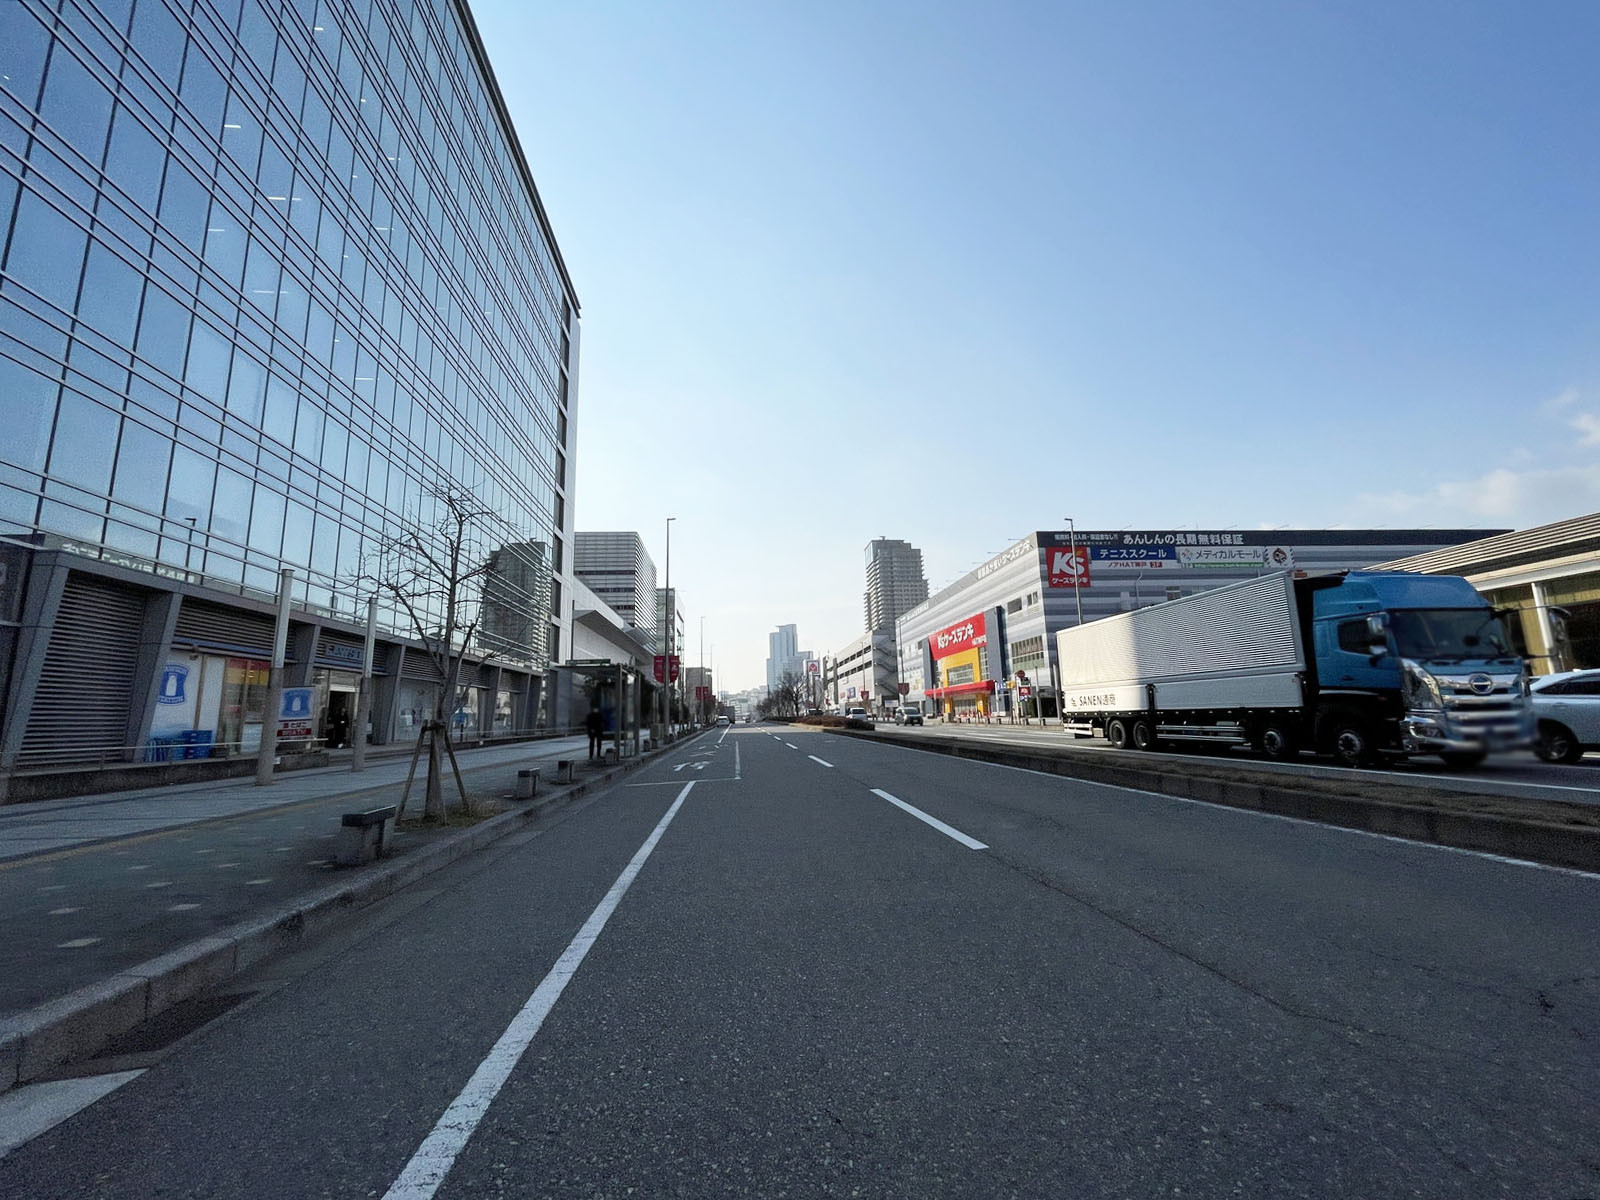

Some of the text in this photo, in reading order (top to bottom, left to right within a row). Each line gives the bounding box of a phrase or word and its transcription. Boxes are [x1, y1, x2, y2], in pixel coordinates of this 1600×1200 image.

[1123, 533, 1244, 545] あんしんの長期無料保証
[1100, 549, 1167, 558] テニススクール
[1196, 550, 1260, 559] メディカルモール
